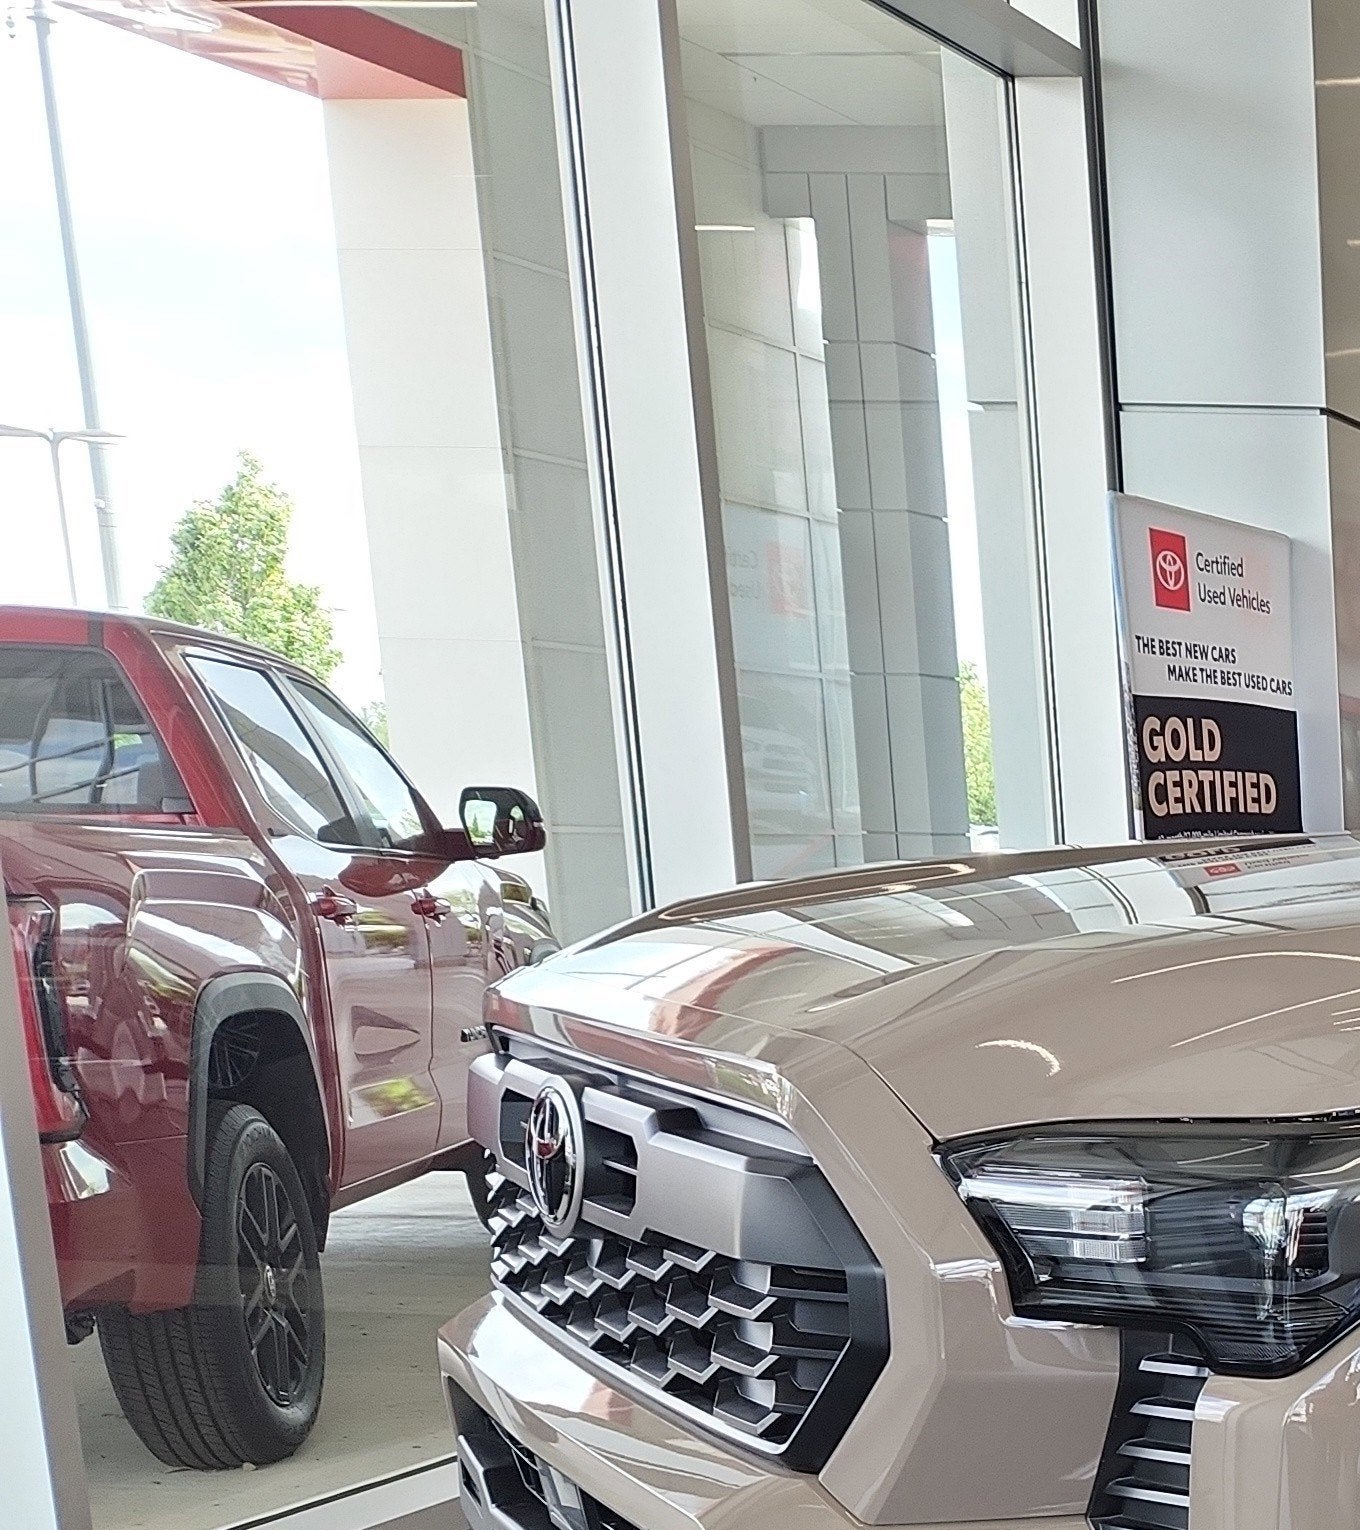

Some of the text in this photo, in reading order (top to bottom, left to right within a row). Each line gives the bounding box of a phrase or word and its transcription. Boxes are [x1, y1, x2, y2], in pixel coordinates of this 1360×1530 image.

[1195, 551, 1245, 579] Certified
[1197, 582, 1271, 615] Used Vehicles
[1134, 634, 1237, 664] THE BEST NEW CARS
[1167, 664, 1293, 696] MAKE THE BEST USED CARS
[1142, 716, 1222, 764] GOLD
[1147, 770, 1278, 817] CERTIFIED
